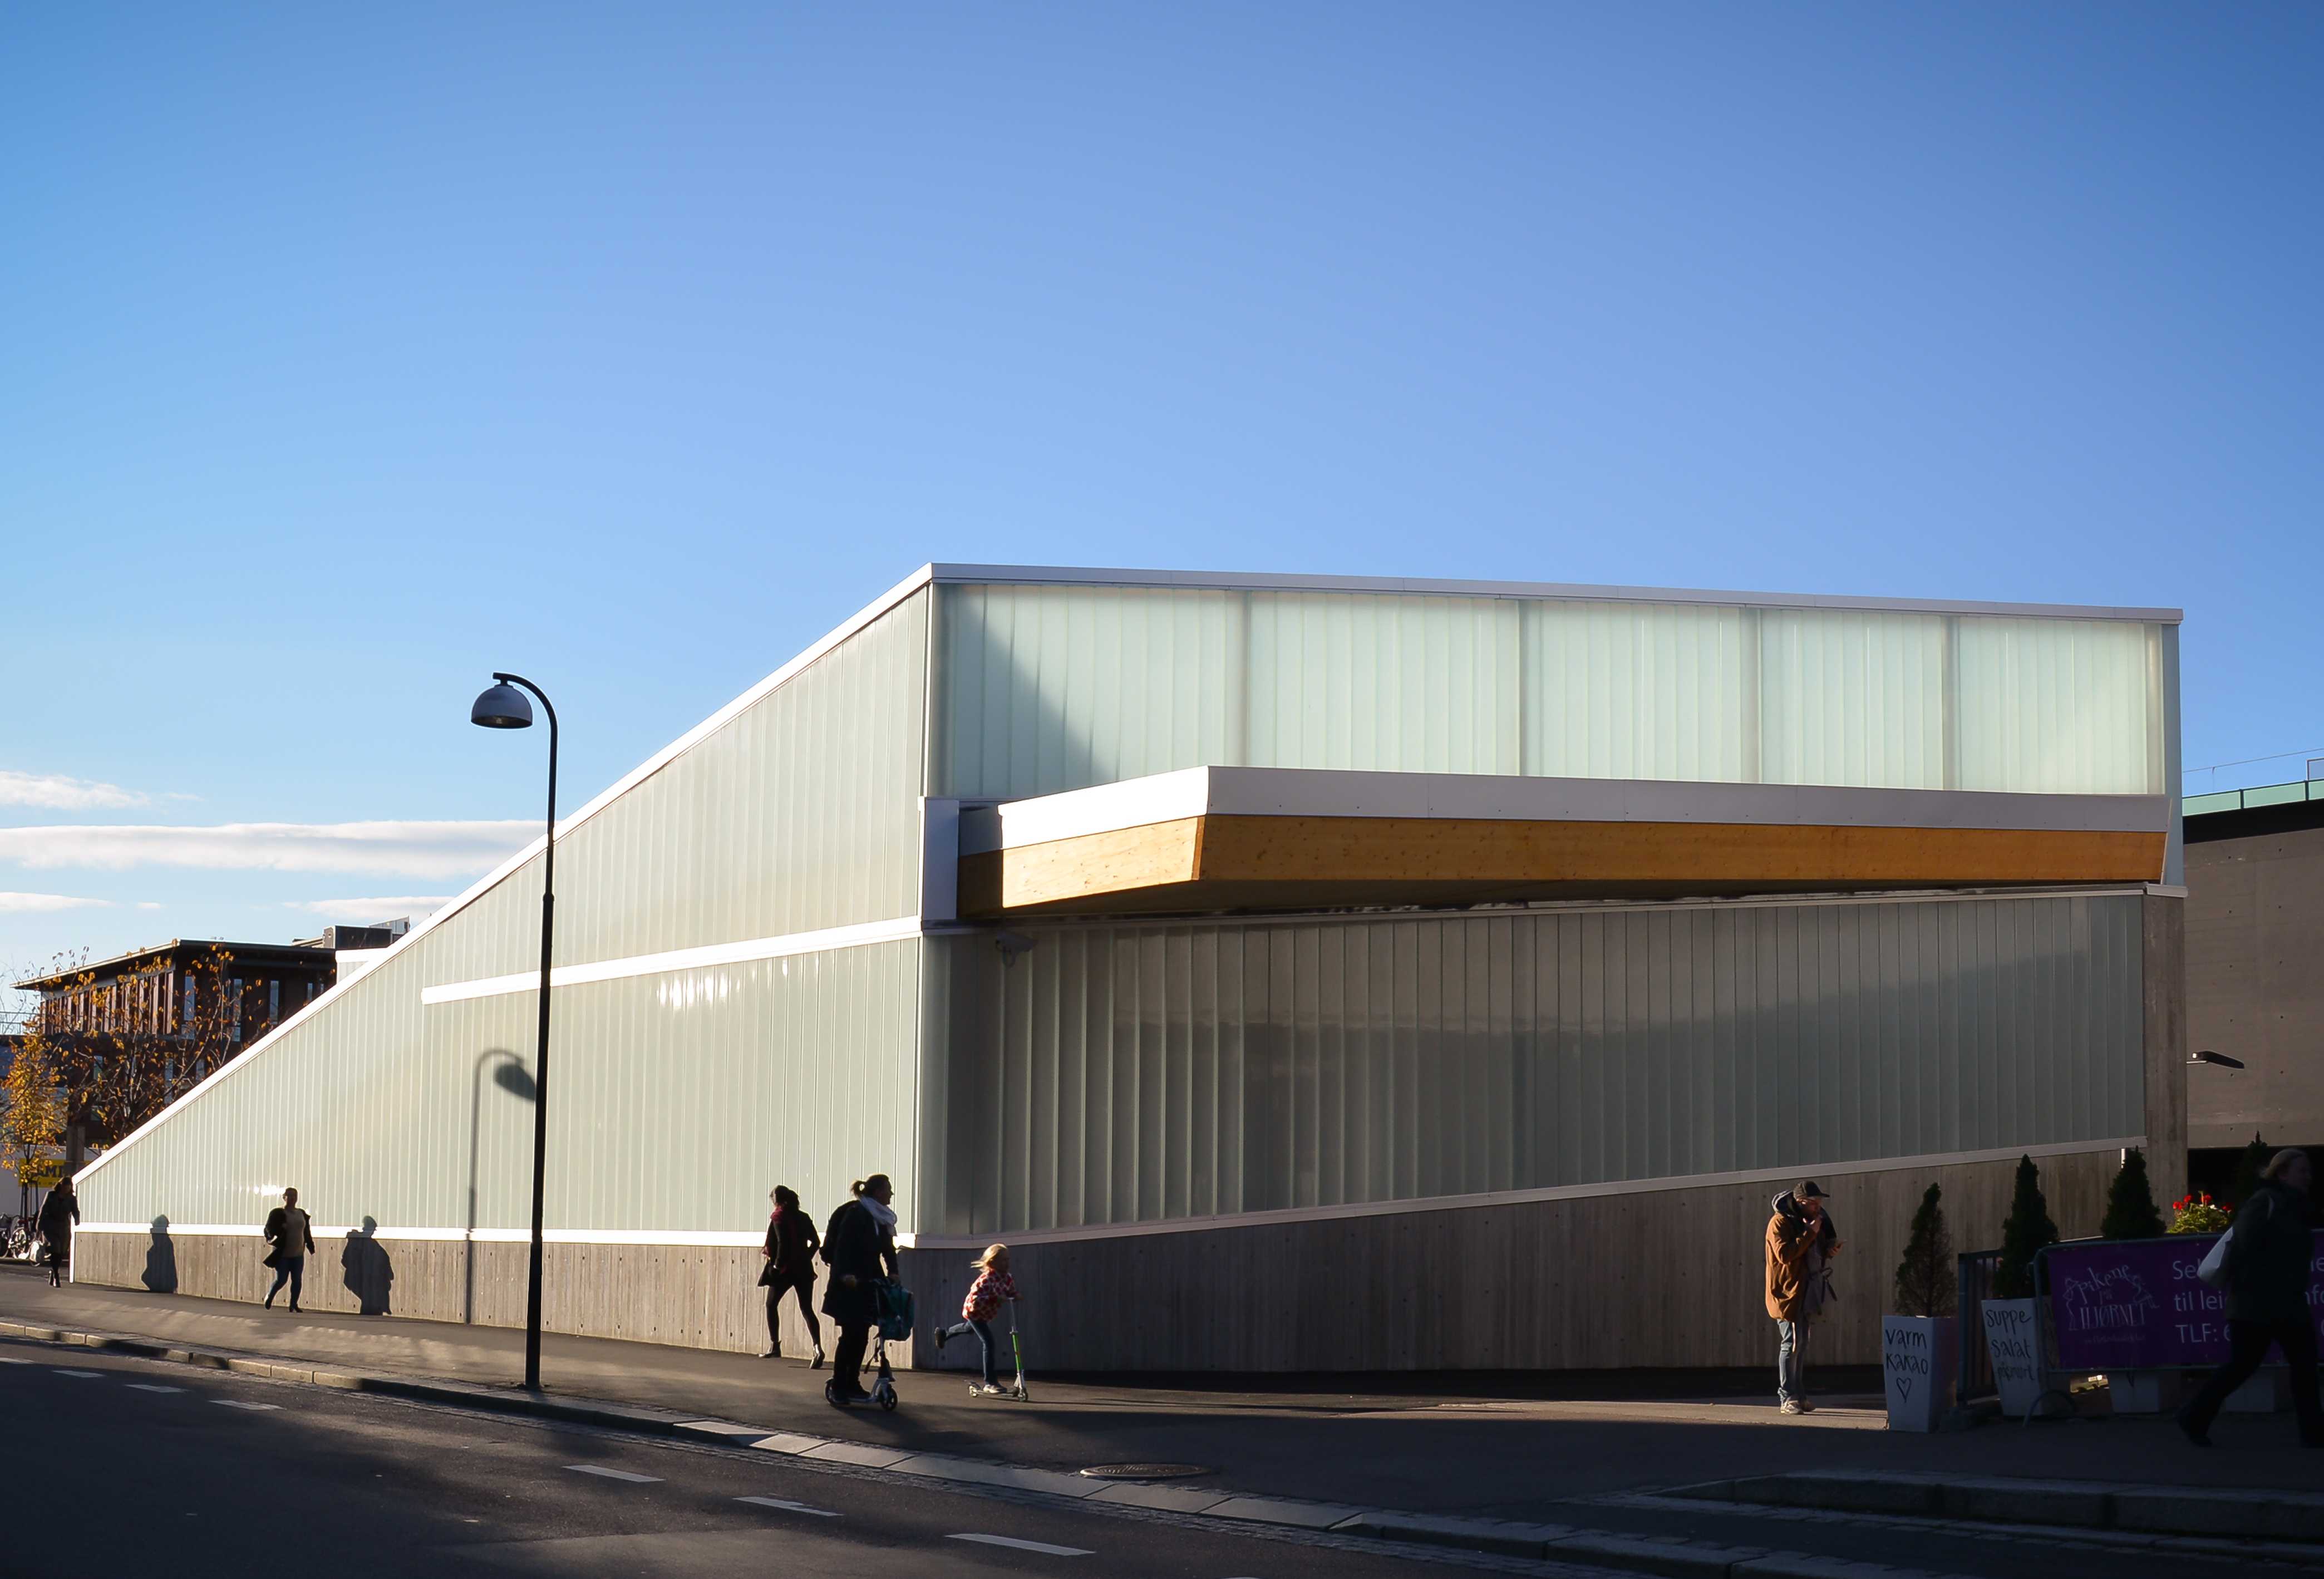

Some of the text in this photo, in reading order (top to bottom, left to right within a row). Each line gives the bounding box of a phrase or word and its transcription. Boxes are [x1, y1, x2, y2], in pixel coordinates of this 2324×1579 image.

[2174, 1289, 2228, 1312] til lei
[2174, 1322, 2218, 1344] TLF:
